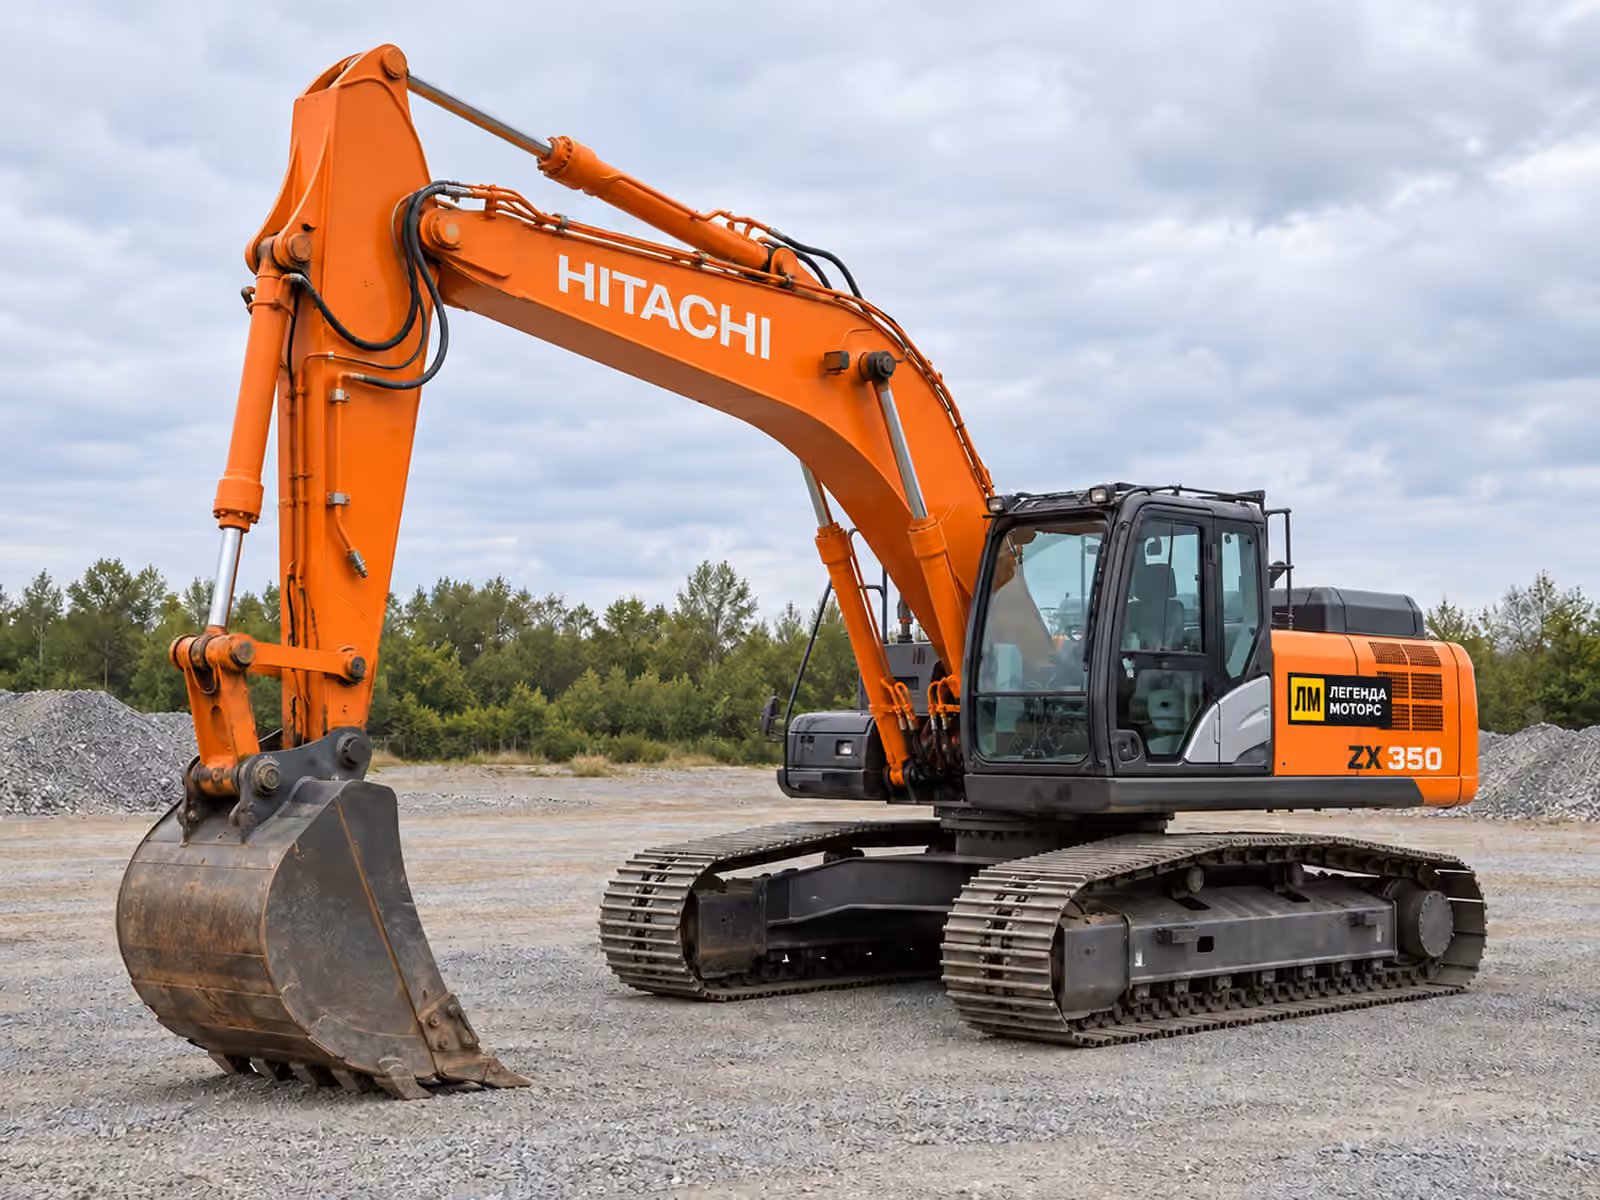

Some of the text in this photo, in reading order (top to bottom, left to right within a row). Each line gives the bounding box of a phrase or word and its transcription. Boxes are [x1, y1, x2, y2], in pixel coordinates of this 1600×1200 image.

[558, 254, 770, 360] HITACHI
[1294, 686, 1321, 712] ЛМ
[1329, 686, 1387, 701] ЛЕГЕНДА
[1329, 703, 1382, 716] МОТОРС
[1347, 746, 1442, 770] ZX 350
